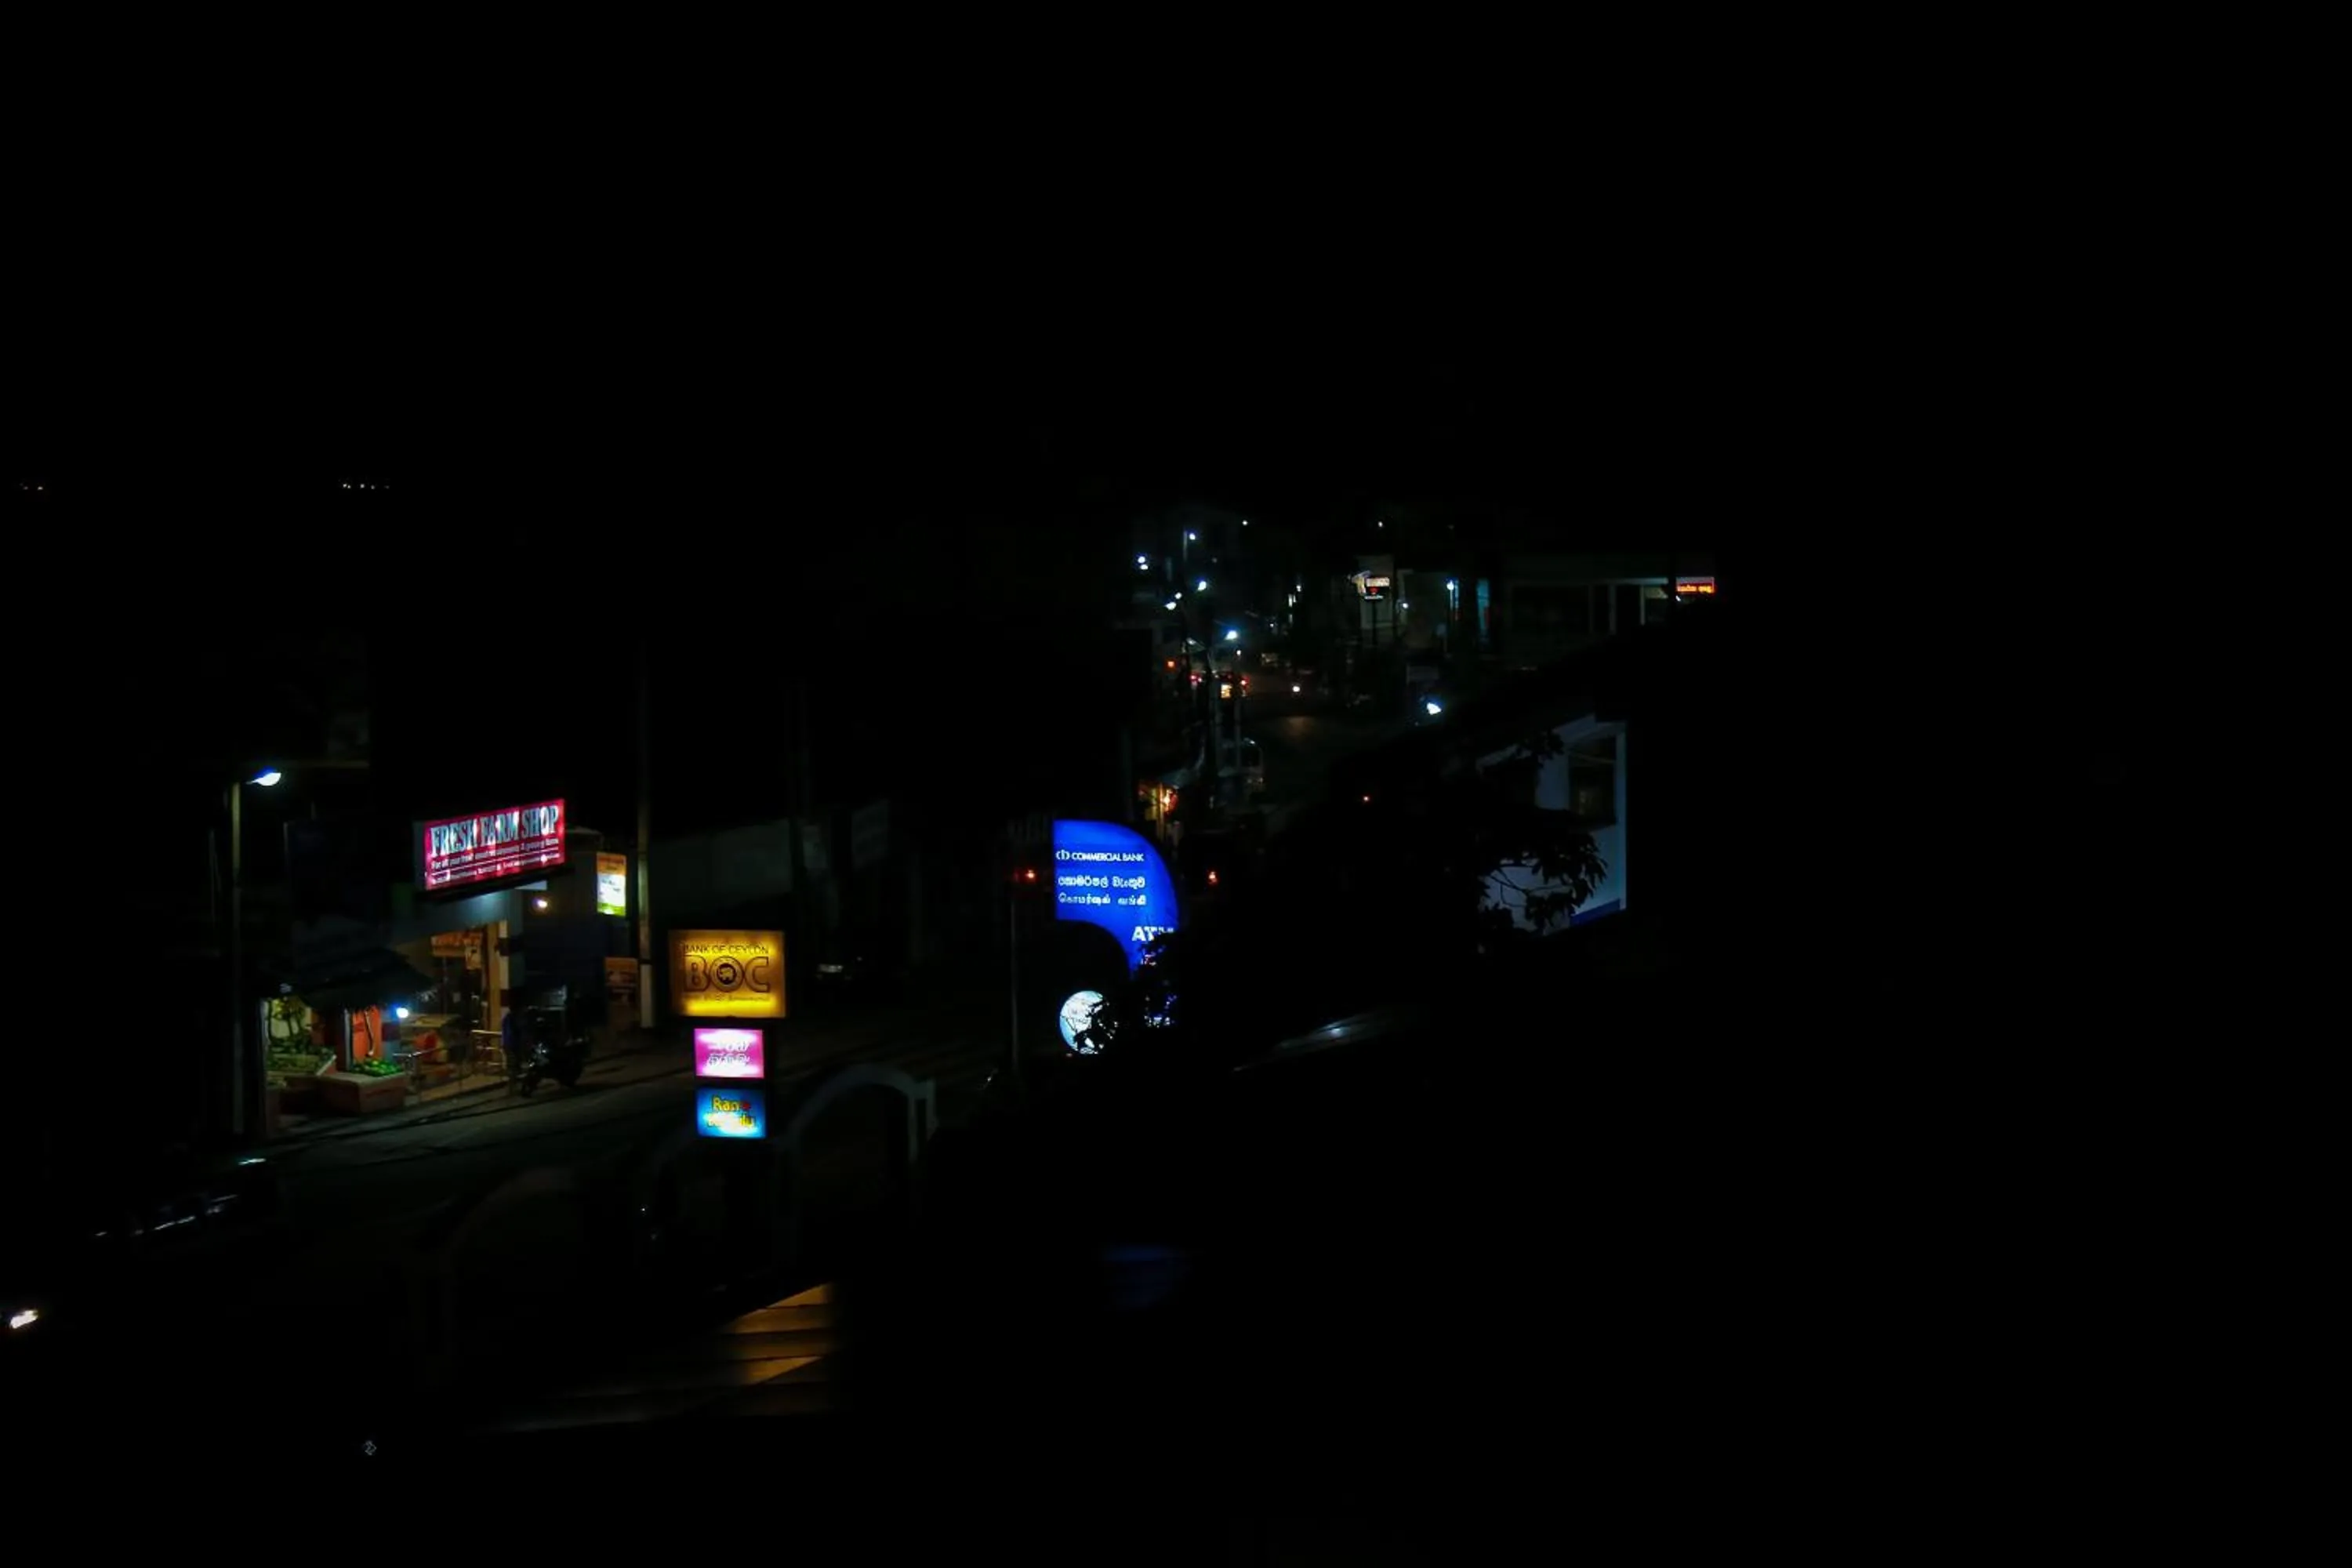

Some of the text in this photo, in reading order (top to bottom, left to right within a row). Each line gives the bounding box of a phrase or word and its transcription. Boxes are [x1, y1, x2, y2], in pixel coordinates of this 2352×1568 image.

[430, 818, 477, 857] FRESH
[480, 811, 519, 845] FARM
[522, 805, 558, 838] SHOP
[1072, 852, 1145, 862] COMMERCIAL BANK
[684, 944, 769, 954] BANK OF CEYLON
[684, 954, 771, 993] BOC
